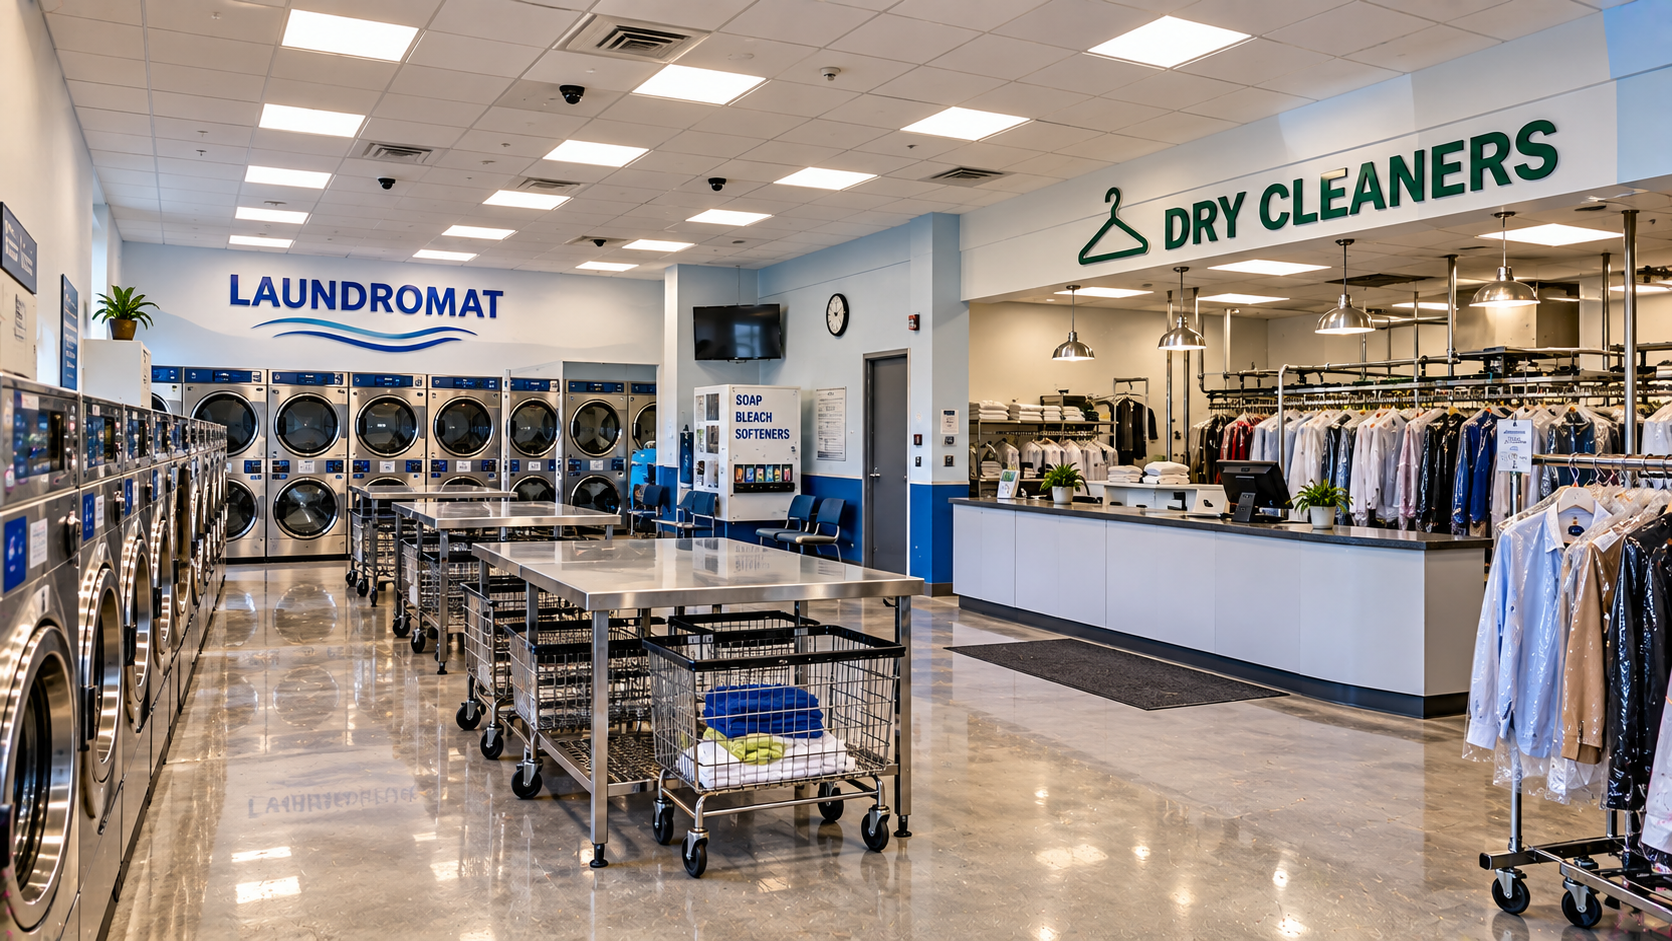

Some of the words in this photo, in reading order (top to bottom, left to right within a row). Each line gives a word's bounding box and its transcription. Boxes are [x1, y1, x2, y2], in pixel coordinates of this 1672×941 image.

[1164, 191, 1247, 250] DRY
[1259, 119, 1559, 231] CLEANERS
[229, 274, 504, 319] LAUNDROMAT
[735, 394, 763, 406] SOAP
[735, 411, 773, 423] BLEACH
[735, 428, 790, 440] SOFTENERS
